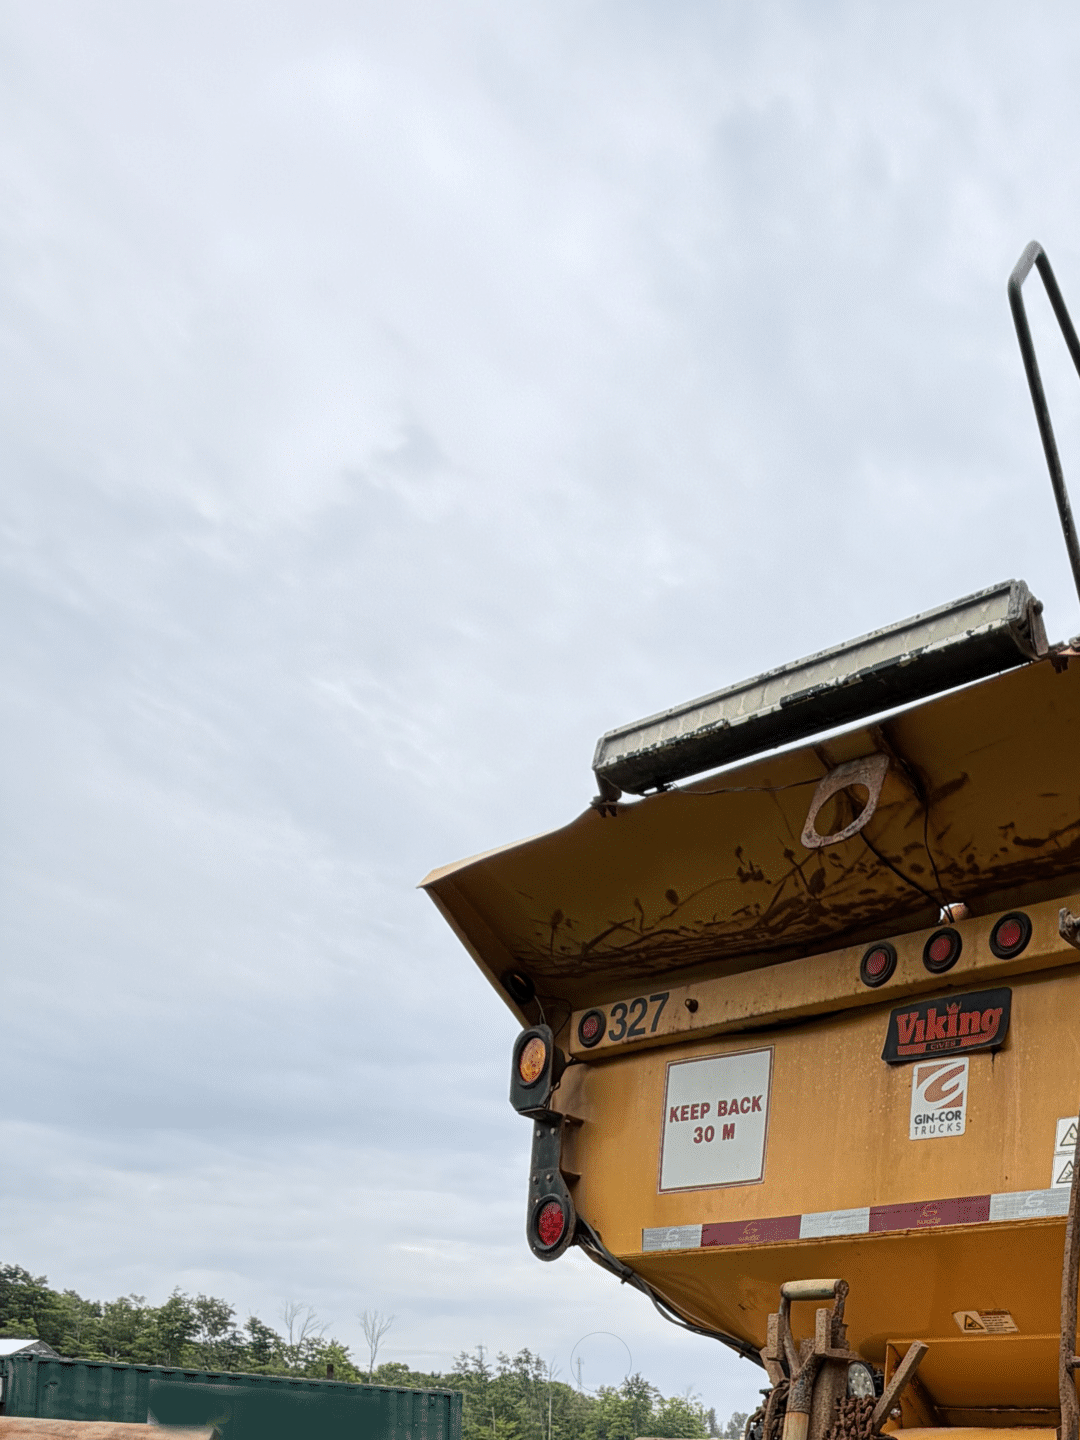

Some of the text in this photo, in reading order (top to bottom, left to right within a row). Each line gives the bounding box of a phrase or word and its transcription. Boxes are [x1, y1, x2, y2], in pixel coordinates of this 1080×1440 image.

[608, 992, 669, 1041] 327
[897, 1006, 1003, 1047] Viking
[669, 1095, 763, 1123] KEEP BACK
[914, 1110, 962, 1125] GIN-COR
[693, 1122, 735, 1144] 30 M
[914, 1122, 962, 1135] TRUCKS
